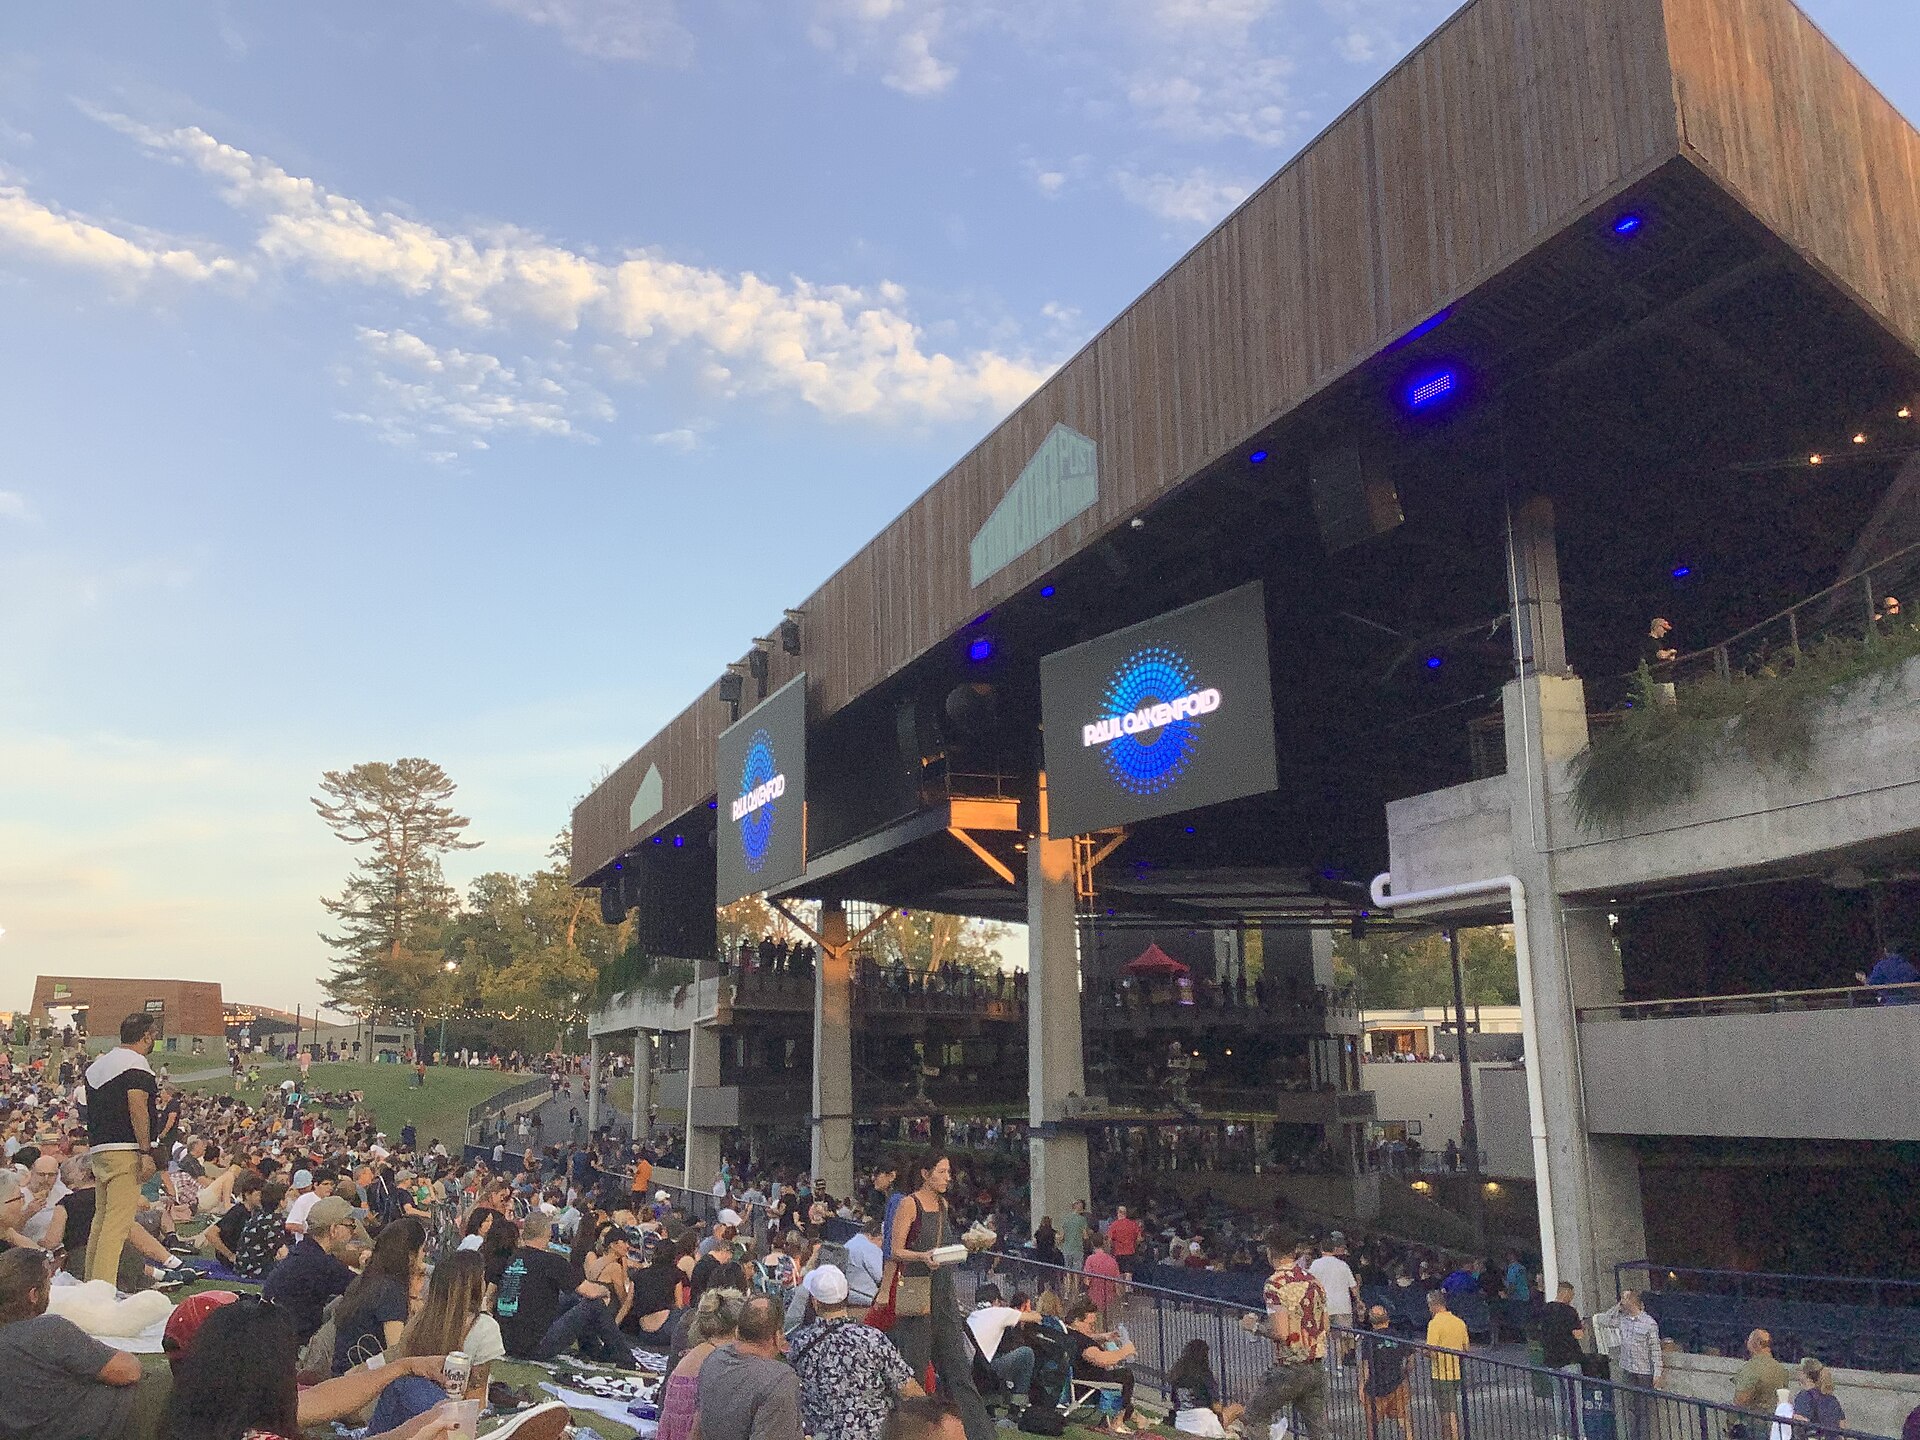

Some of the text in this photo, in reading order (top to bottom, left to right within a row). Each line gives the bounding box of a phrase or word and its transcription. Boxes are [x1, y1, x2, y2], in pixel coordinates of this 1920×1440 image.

[1083, 688, 1221, 747] PAUL OAKENFOLD
[732, 795, 748, 821] PAUL
